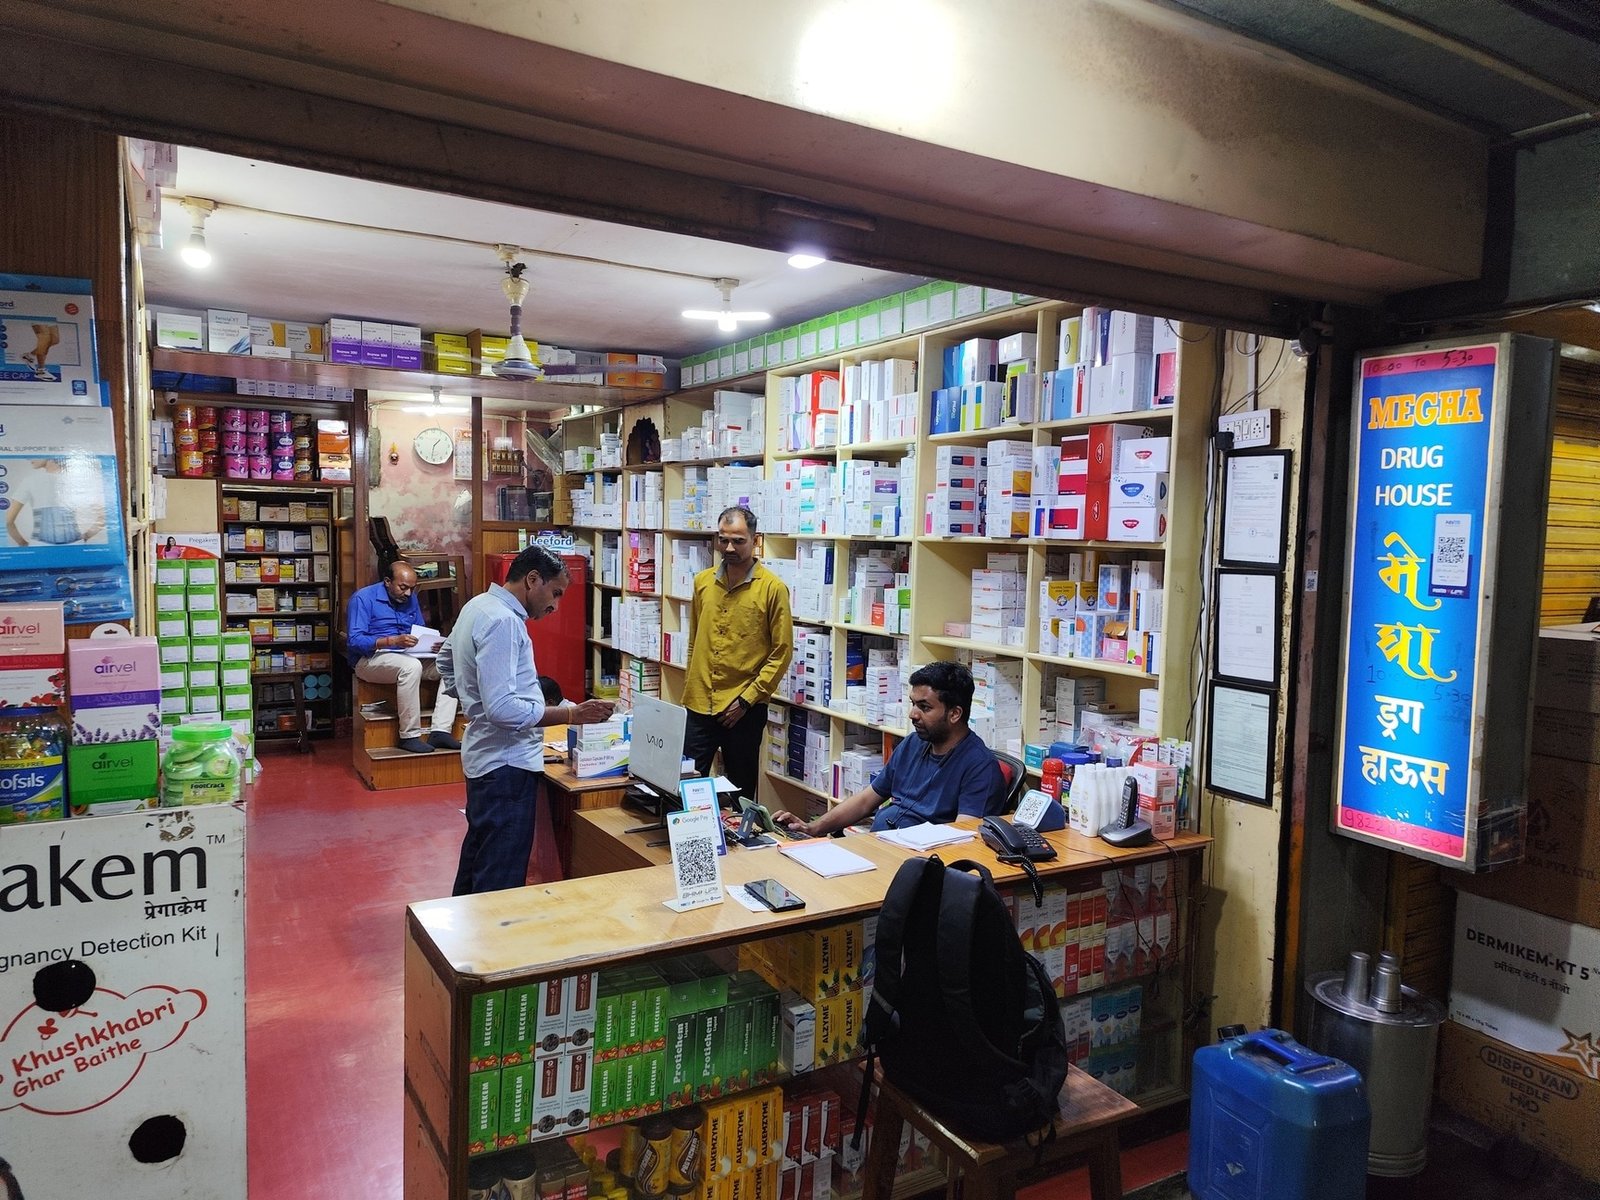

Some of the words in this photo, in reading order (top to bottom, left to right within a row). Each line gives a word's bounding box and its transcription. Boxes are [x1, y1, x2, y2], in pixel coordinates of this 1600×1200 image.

[12, 372, 30, 380] CAP
[1368, 388, 1483, 429] MEGHA
[1381, 445, 1443, 470] DRUG
[1375, 483, 1453, 506] HOUSE
[529, 535, 574, 546] Leeford
[94, 661, 137, 675] airvel
[1374, 695, 1425, 740] ड्रग
[646, 733, 664, 749] VAIO
[92, 757, 134, 770] airvel
[1358, 745, 1450, 796] हाऊस
[190, 782, 225, 790] FootCrack
[206, 834, 225, 845] TM
[681, 816, 700, 826] Google
[144, 897, 207, 920] प्रेगाकेम
[80, 932, 175, 958] Detection
[182, 926, 207, 942] Kit
[822, 936, 830, 975] ALZYME
[1580, 963, 1590, 981] 5
[12, 997, 175, 1077] Khushkhabri
[484, 998, 494, 1047] BEECEEKEM
[518, 993, 528, 1041] BEECEEKEM
[822, 1004, 830, 1045] ALZYME
[13, 1069, 65, 1098] Ghar
[74, 1037, 142, 1073] Baithe
[672, 1022, 684, 1085] Protichem
[702, 1016, 713, 1078] Protichem
[1486, 1052, 1534, 1079] DISPO
[1540, 1071, 1573, 1095] VAN
[1501, 1075, 1550, 1103] NEEDLE
[481, 1081, 489, 1130] BEECEEKEM
[513, 1075, 523, 1123] BEECEEKEM
[710, 1116, 719, 1173] ALKEMZYME
[736, 1109, 745, 1164] ALKEMZYME
[761, 1101, 769, 1157] ALKEMZYME
